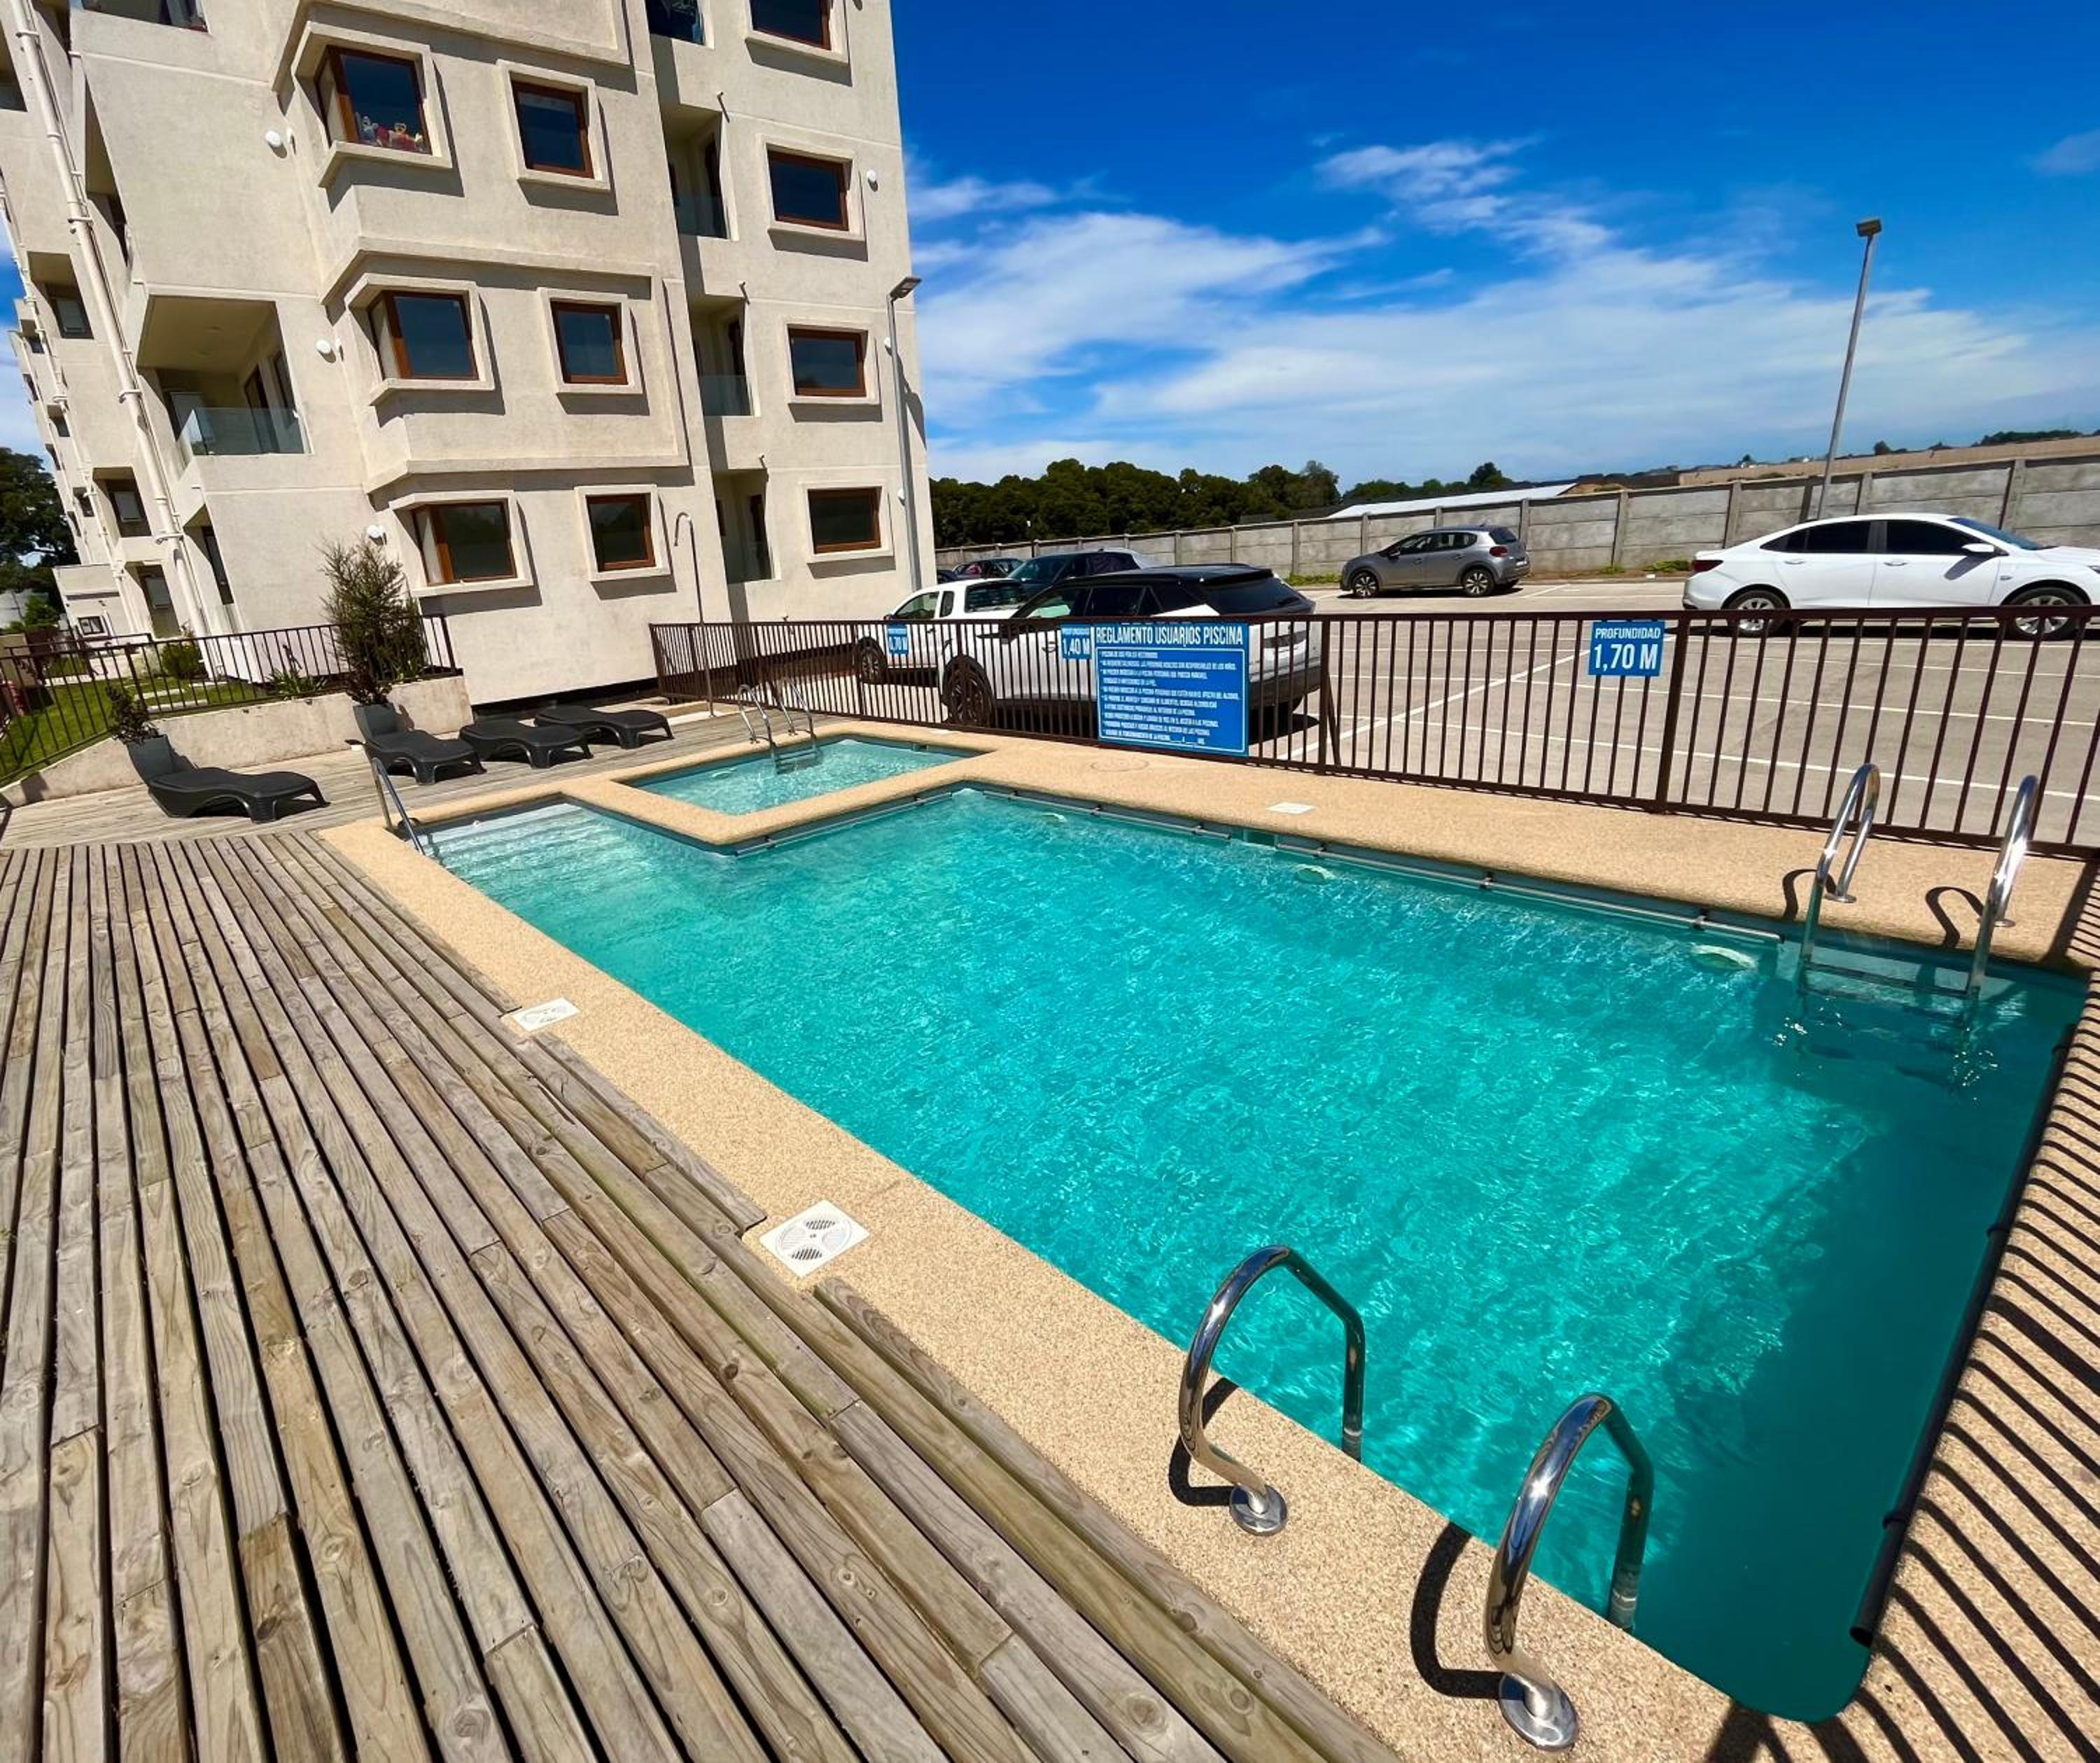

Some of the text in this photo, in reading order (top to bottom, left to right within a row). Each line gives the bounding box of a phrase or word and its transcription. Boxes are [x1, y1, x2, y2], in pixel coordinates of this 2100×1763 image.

[1096, 627, 1153, 643] REGLAMENTO
[1156, 627, 1200, 646] USUARIOS
[1203, 627, 1243, 645] PISCINA
[1595, 627, 1661, 639] PROFUNDIDAD
[1063, 638, 1081, 656] 1,40
[1082, 638, 1089, 655] M
[1594, 643, 1658, 671] 1,70 M
